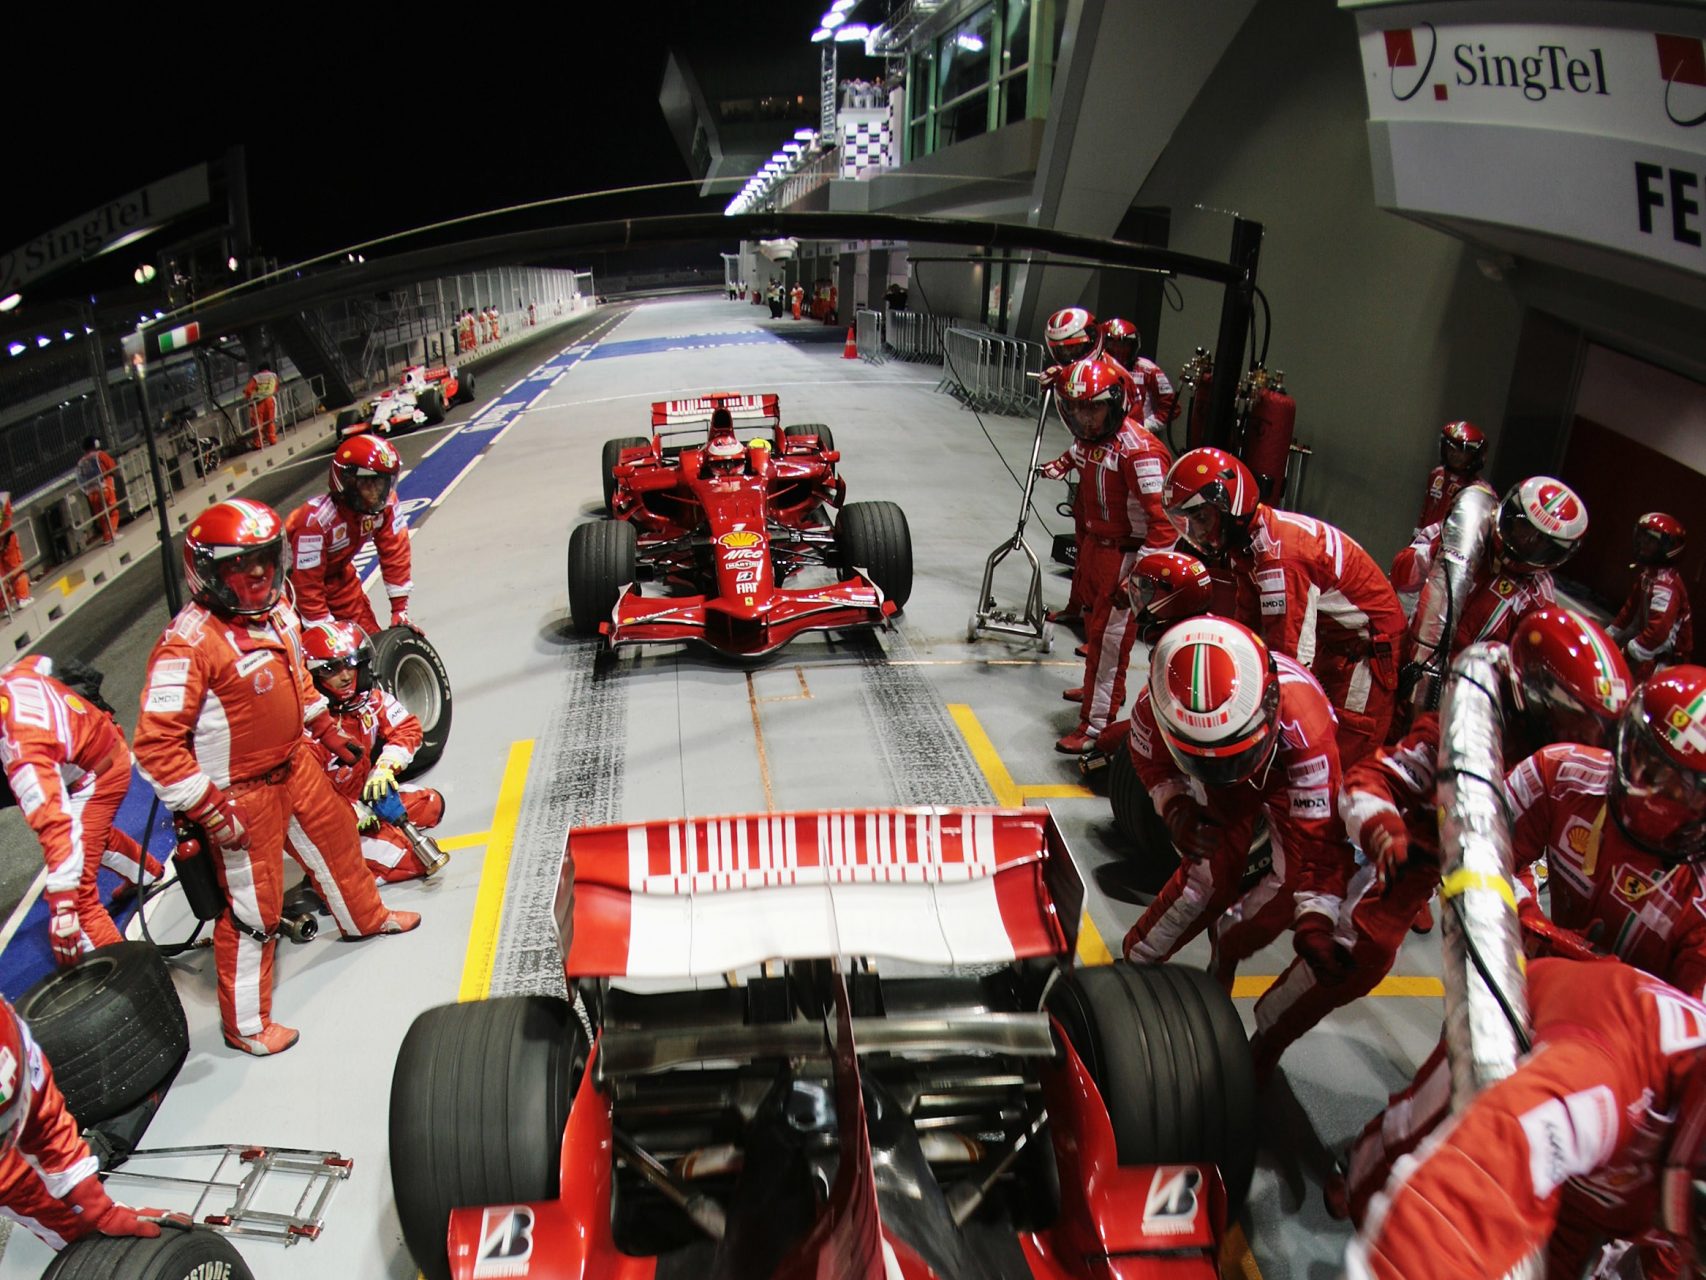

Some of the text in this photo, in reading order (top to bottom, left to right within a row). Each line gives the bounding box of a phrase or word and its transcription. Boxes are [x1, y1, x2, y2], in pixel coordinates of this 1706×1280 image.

[1454, 43, 1611, 101] SingTel
[25, 189, 151, 271] SingTel
[736, 583, 758, 594] FIAT
